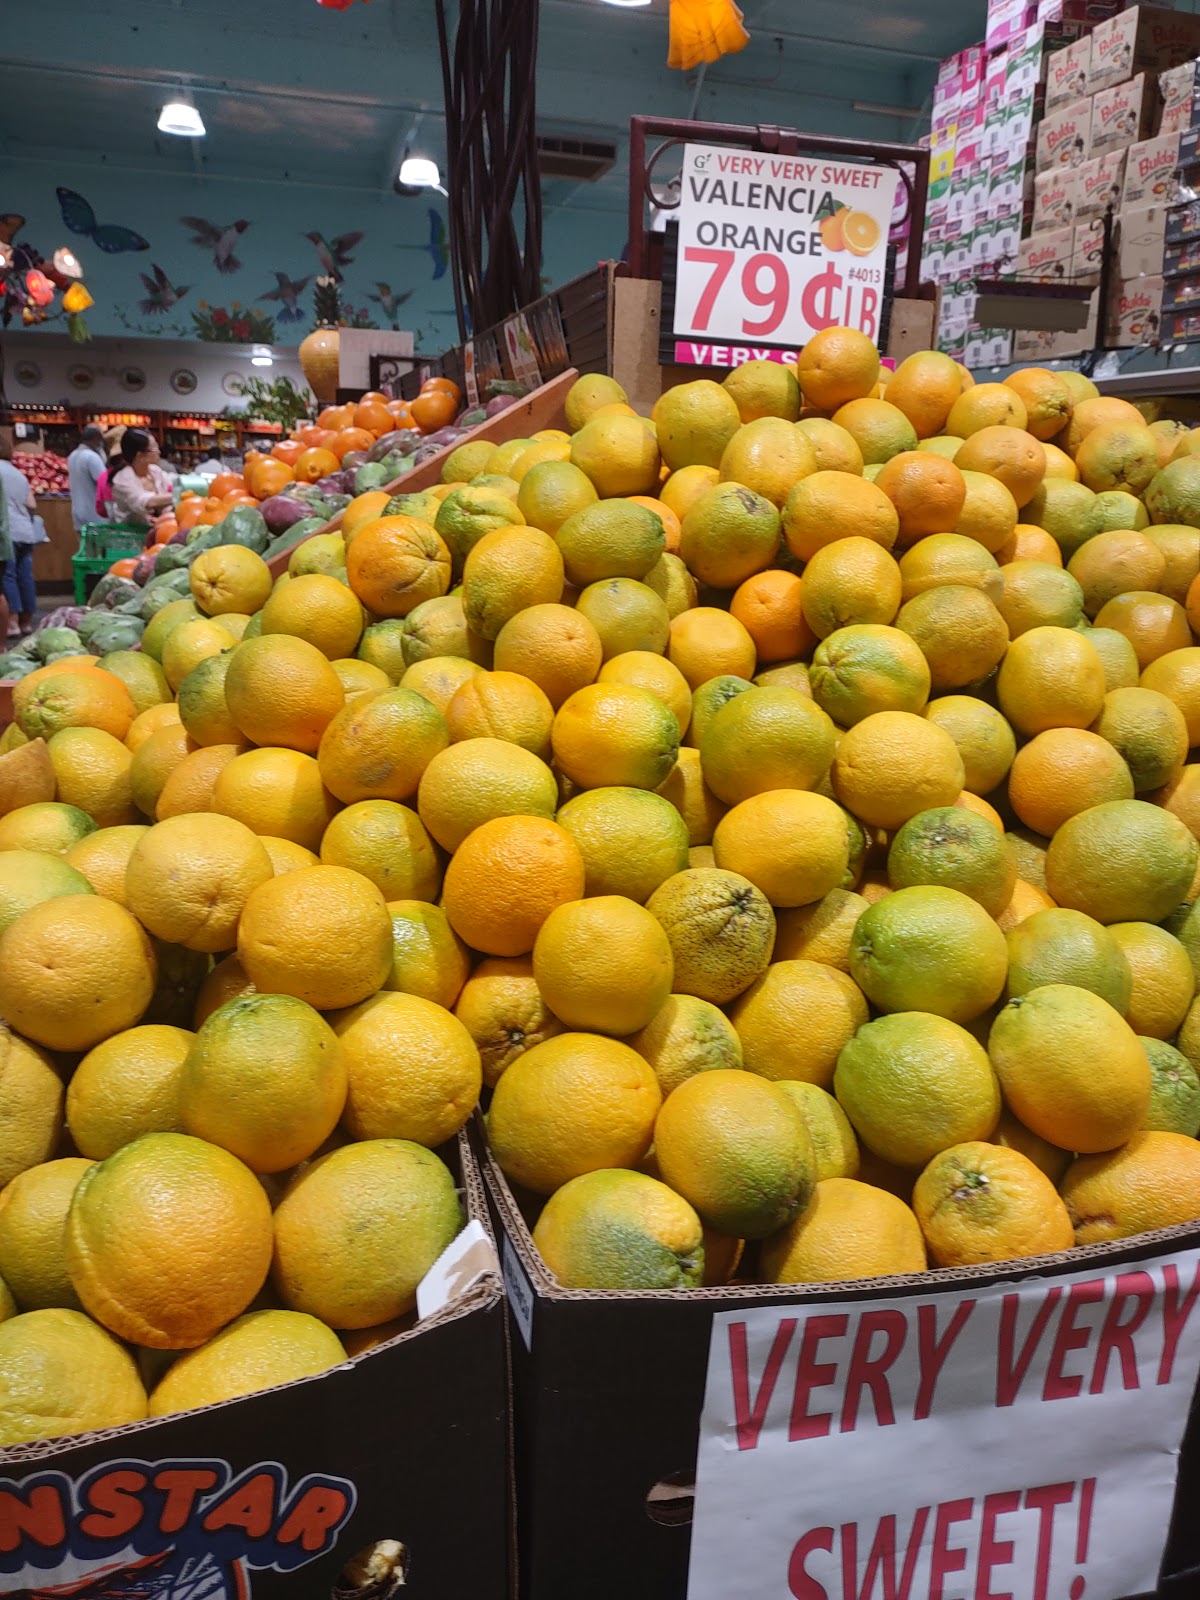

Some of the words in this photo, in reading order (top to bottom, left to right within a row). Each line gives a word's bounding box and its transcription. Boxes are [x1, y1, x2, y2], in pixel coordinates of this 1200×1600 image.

[717, 154, 765, 176] VERY
[771, 160, 819, 182] VERY
[822, 167, 883, 189] SWEET
[689, 176, 836, 217] VALENCIA
[696, 220, 823, 257] ORANGE
[848, 267, 881, 284] #4013
[690, 342, 771, 366] VERY
[727, 1298, 976, 1452] VERY
[995, 1258, 1200, 1408] VERY
[787, 1477, 1097, 1600] SWEET!
